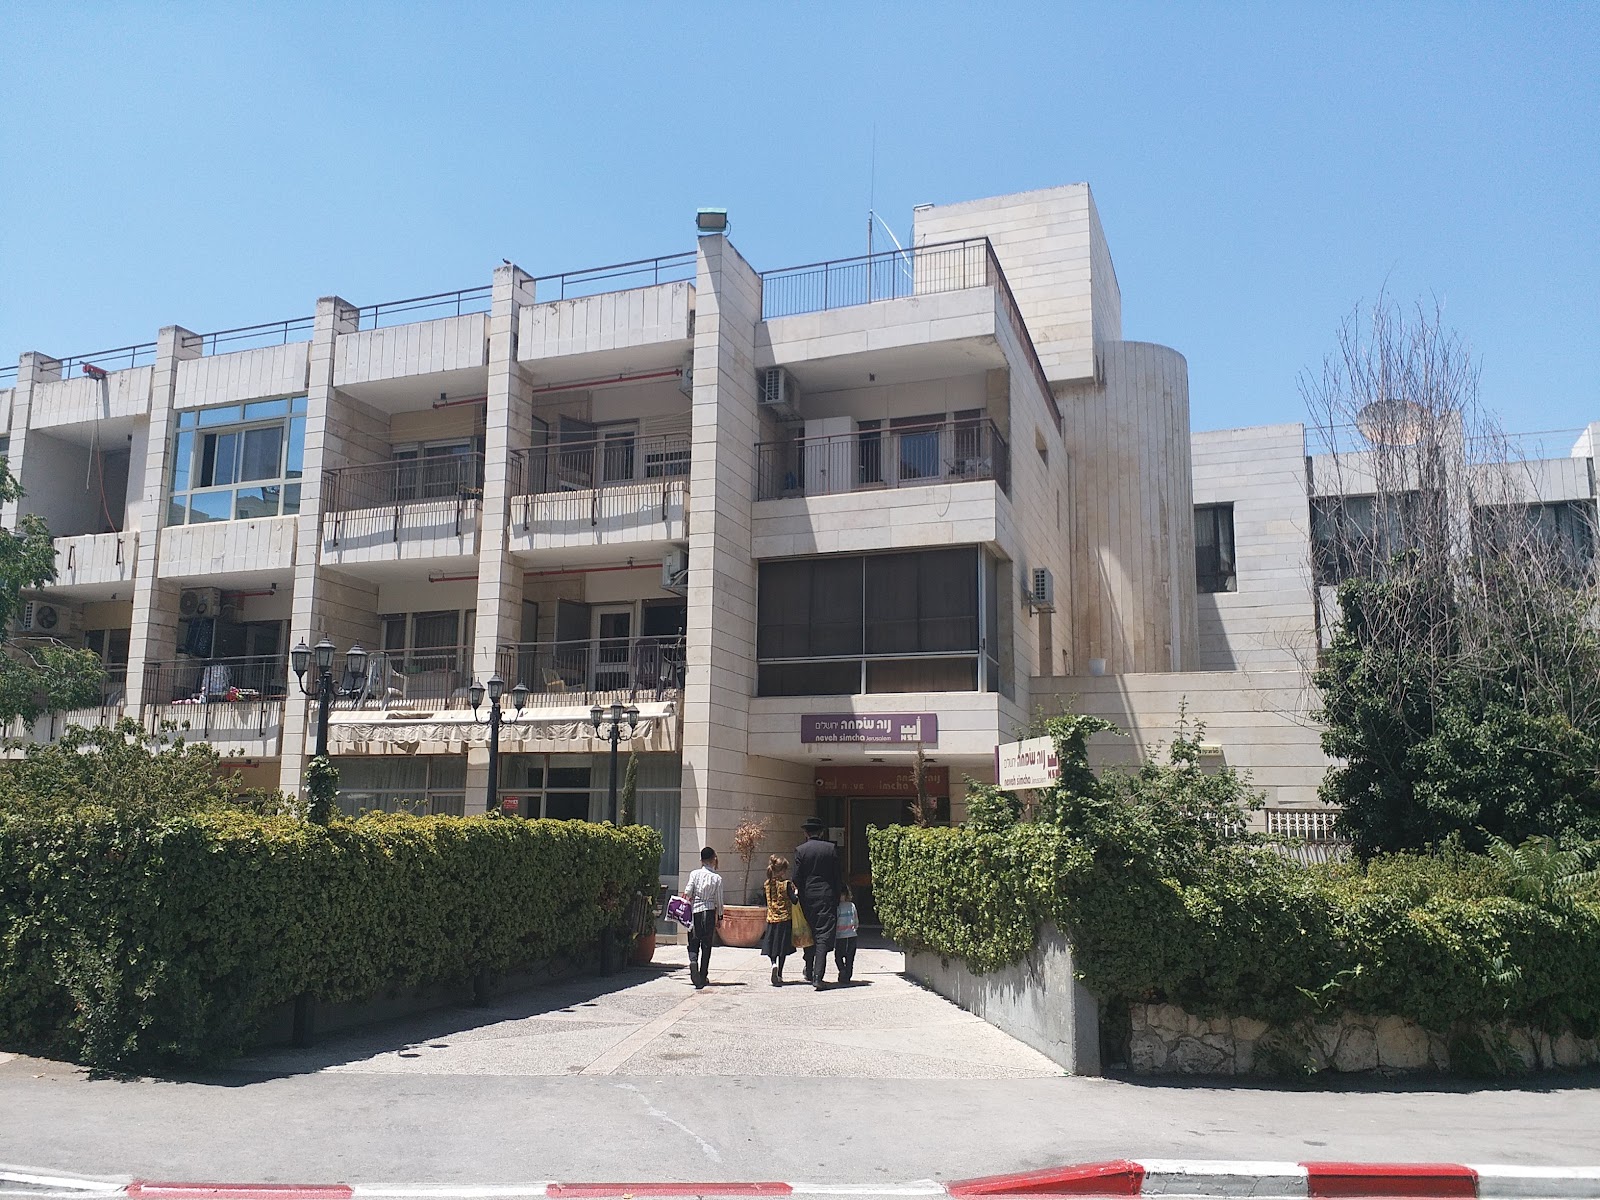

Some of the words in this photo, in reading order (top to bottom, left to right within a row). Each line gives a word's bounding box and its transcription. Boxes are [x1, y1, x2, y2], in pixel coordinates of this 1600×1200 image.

[876, 719, 892, 733] נוה
[815, 733, 838, 741] neveh
[839, 733, 865, 741] simcha
